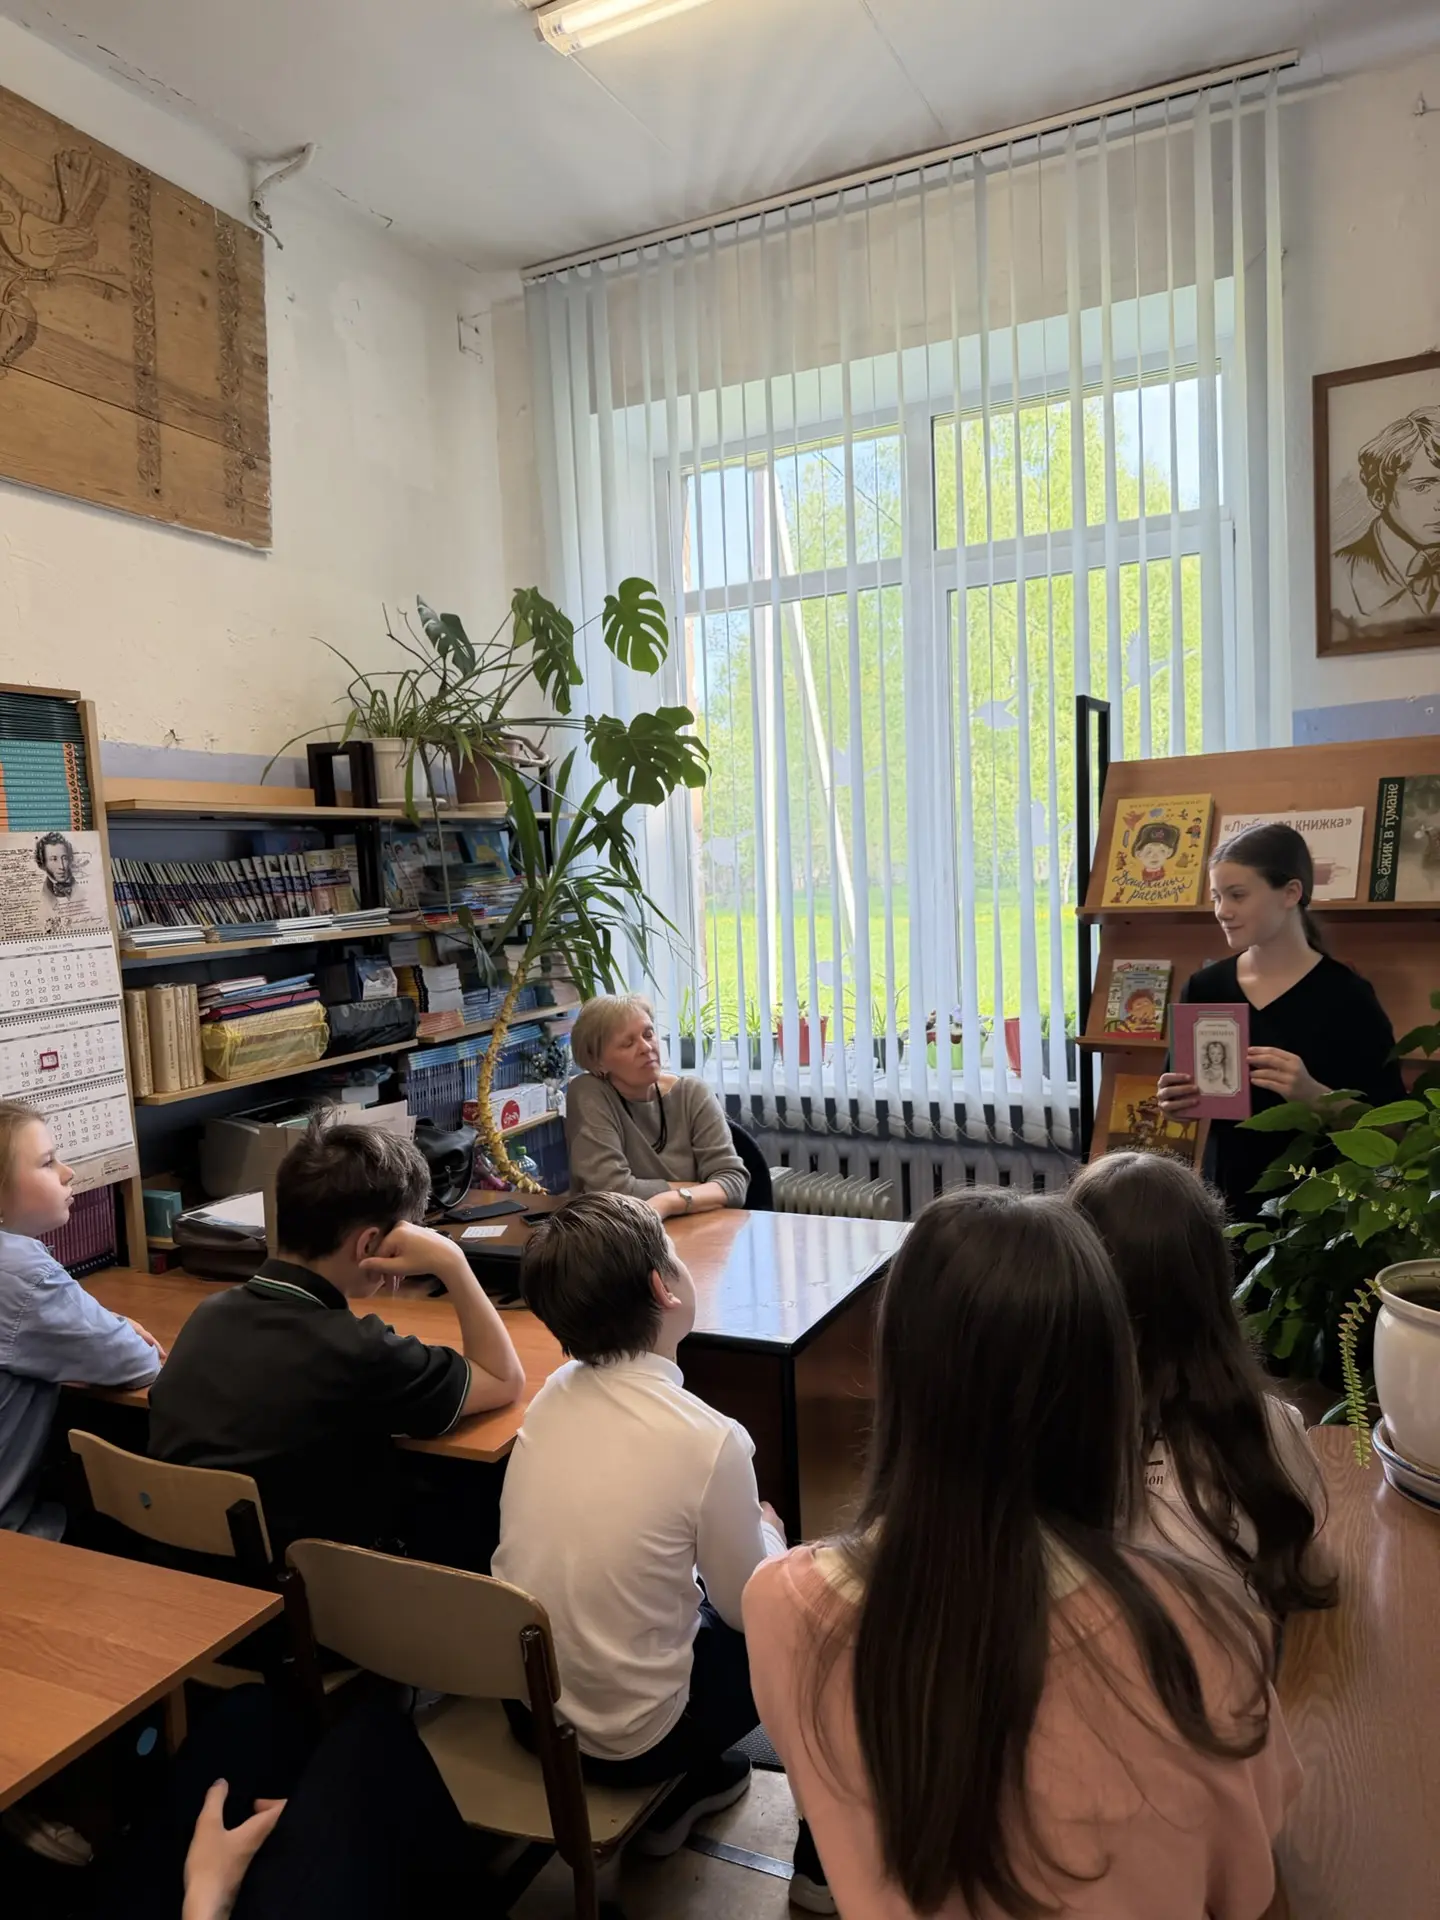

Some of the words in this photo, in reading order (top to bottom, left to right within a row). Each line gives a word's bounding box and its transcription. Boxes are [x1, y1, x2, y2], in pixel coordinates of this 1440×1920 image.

[1384, 783, 1399, 828] тумане
[1295, 817, 1352, 832] книжка»
[1383, 830, 1395, 839] в
[1377, 841, 1394, 875] ёжик
[68, 1130, 76, 1138] 18
[104, 1120, 113, 1128] 21
[68, 1139, 78, 1147] 25
[93, 1132, 101, 1140] 27
[105, 1129, 114, 1137] 28
[1145, 1472, 1164, 1485] ion
